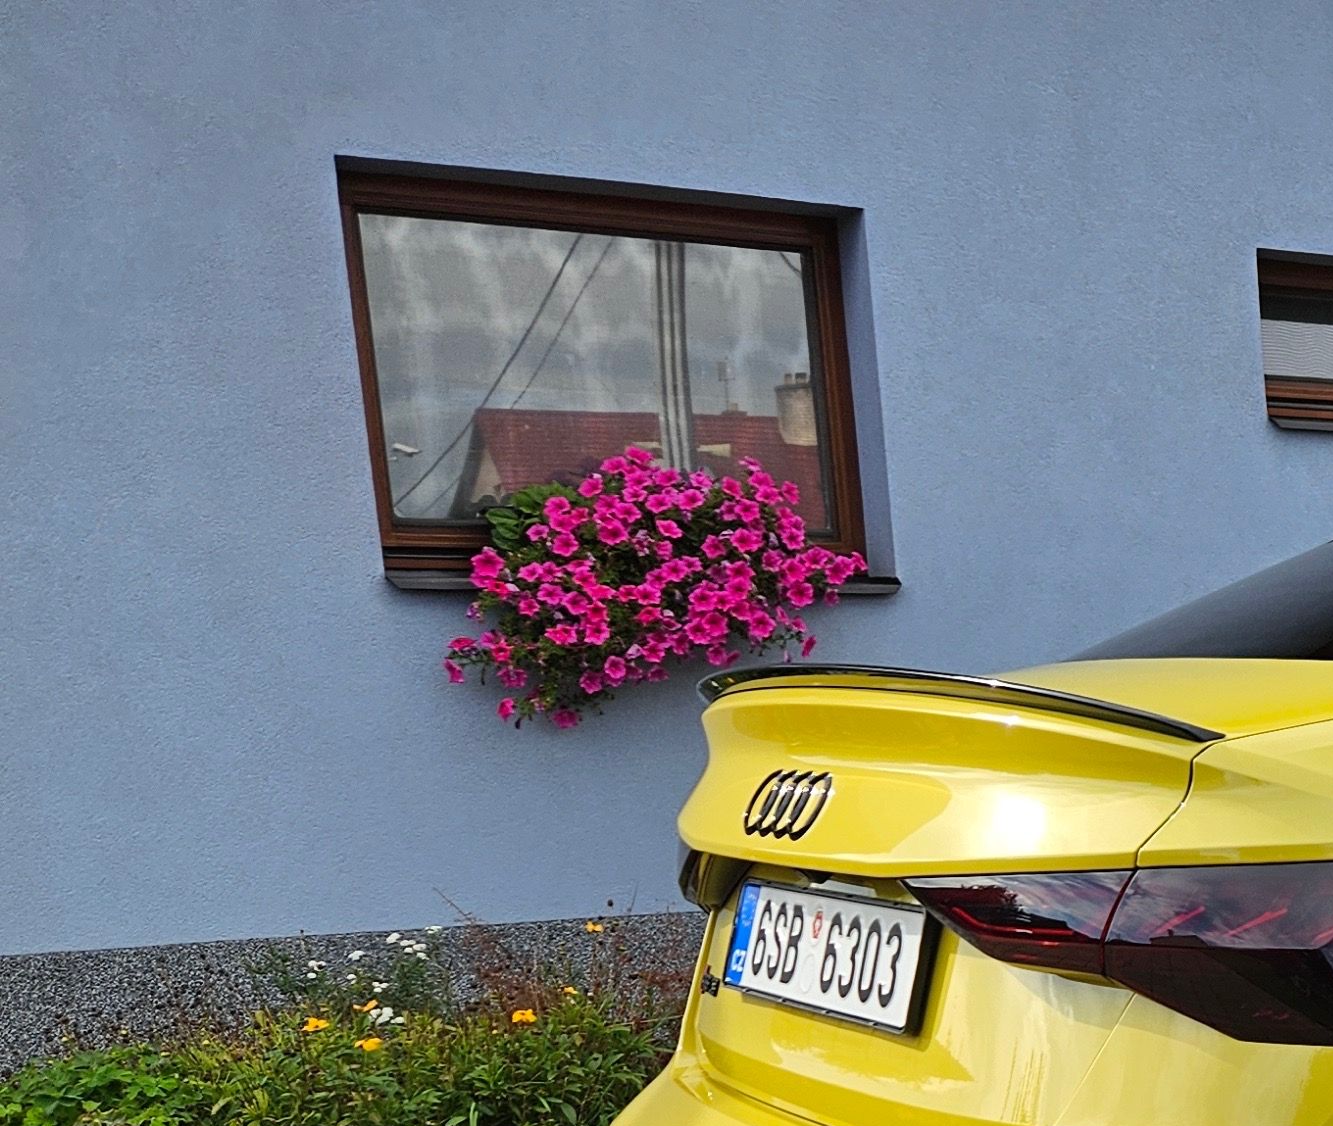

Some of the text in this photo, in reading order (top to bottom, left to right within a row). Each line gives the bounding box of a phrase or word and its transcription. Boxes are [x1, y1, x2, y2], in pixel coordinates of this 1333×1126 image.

[731, 950, 746, 973] CZ
[751, 899, 902, 1008] 6SB 6303
